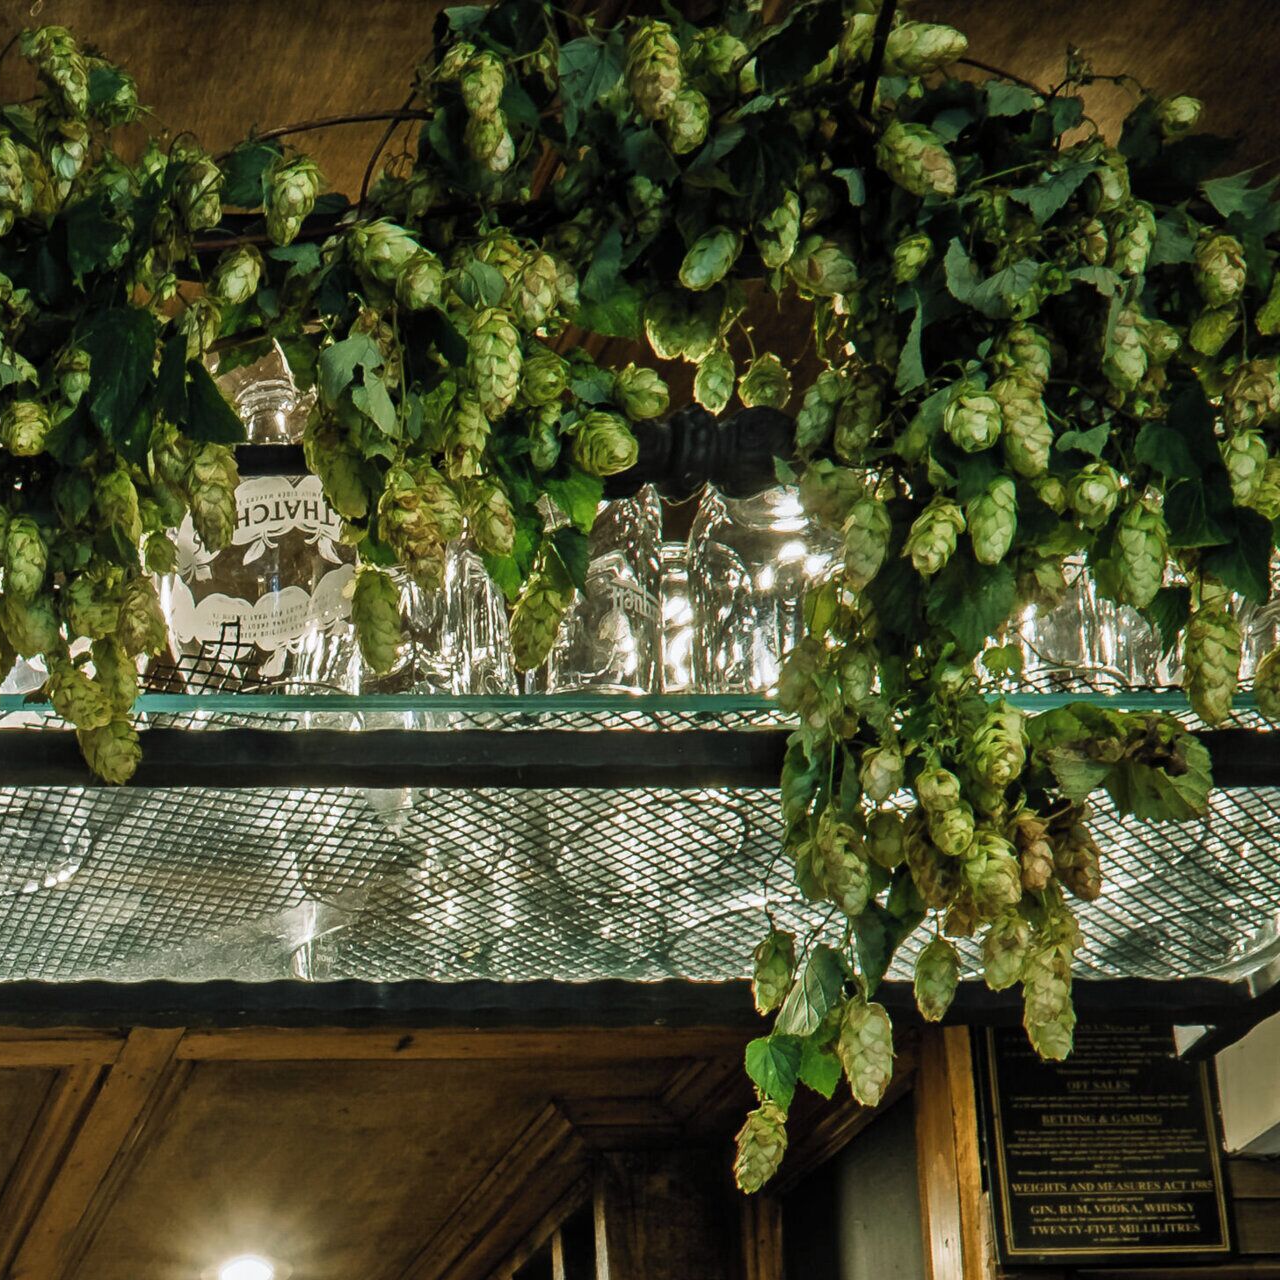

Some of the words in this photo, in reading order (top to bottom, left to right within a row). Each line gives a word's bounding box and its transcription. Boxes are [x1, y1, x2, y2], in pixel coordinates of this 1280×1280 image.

[1012, 1183, 1067, 1193] WEIGHTS
[1071, 1182, 1093, 1192] AND
[1097, 1182, 1160, 1192] MEASURES
[1165, 1181, 1186, 1190] ACT
[1145, 1203, 1195, 1213] WHISKY
[1030, 1225, 1116, 1234] TWENTY-FIVE
[1120, 1224, 1200, 1233] MILLILITRES
